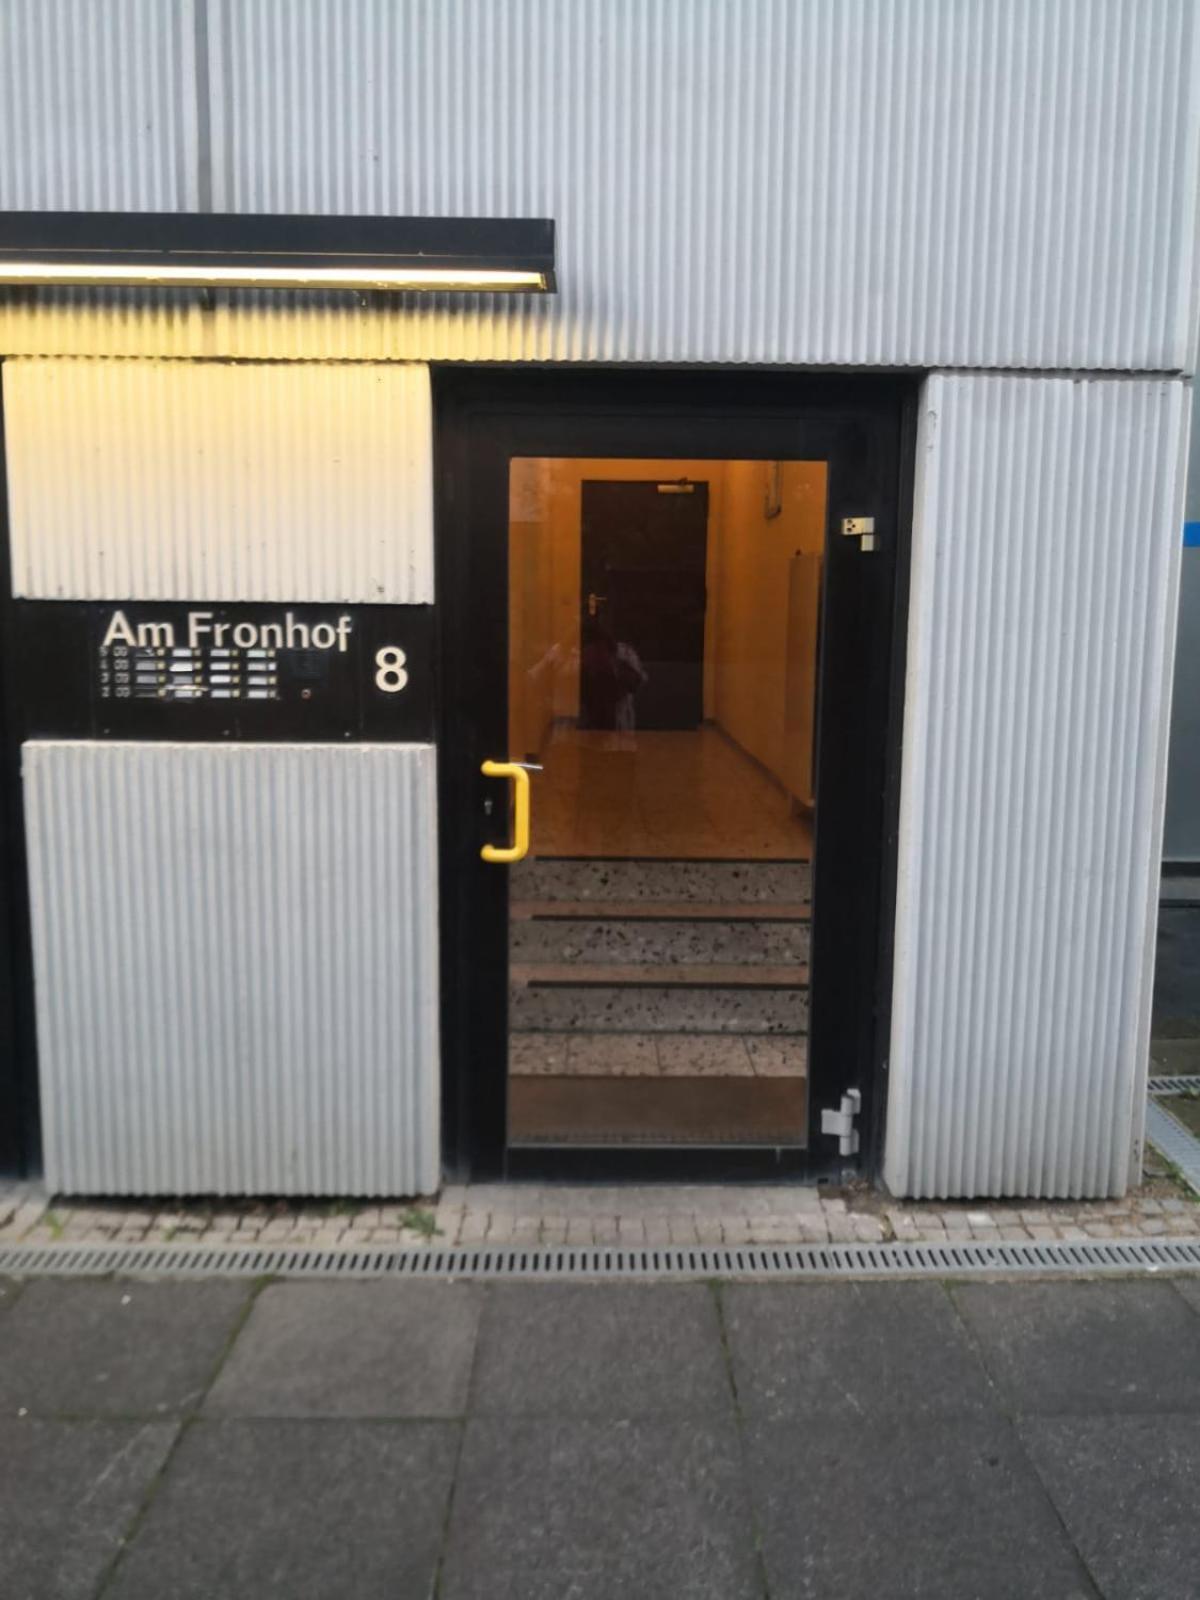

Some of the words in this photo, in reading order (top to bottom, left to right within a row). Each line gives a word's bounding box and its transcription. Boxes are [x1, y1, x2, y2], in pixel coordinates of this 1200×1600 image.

[103, 610, 175, 648] Am
[187, 611, 352, 652] Fronhof
[374, 645, 409, 693] 8
